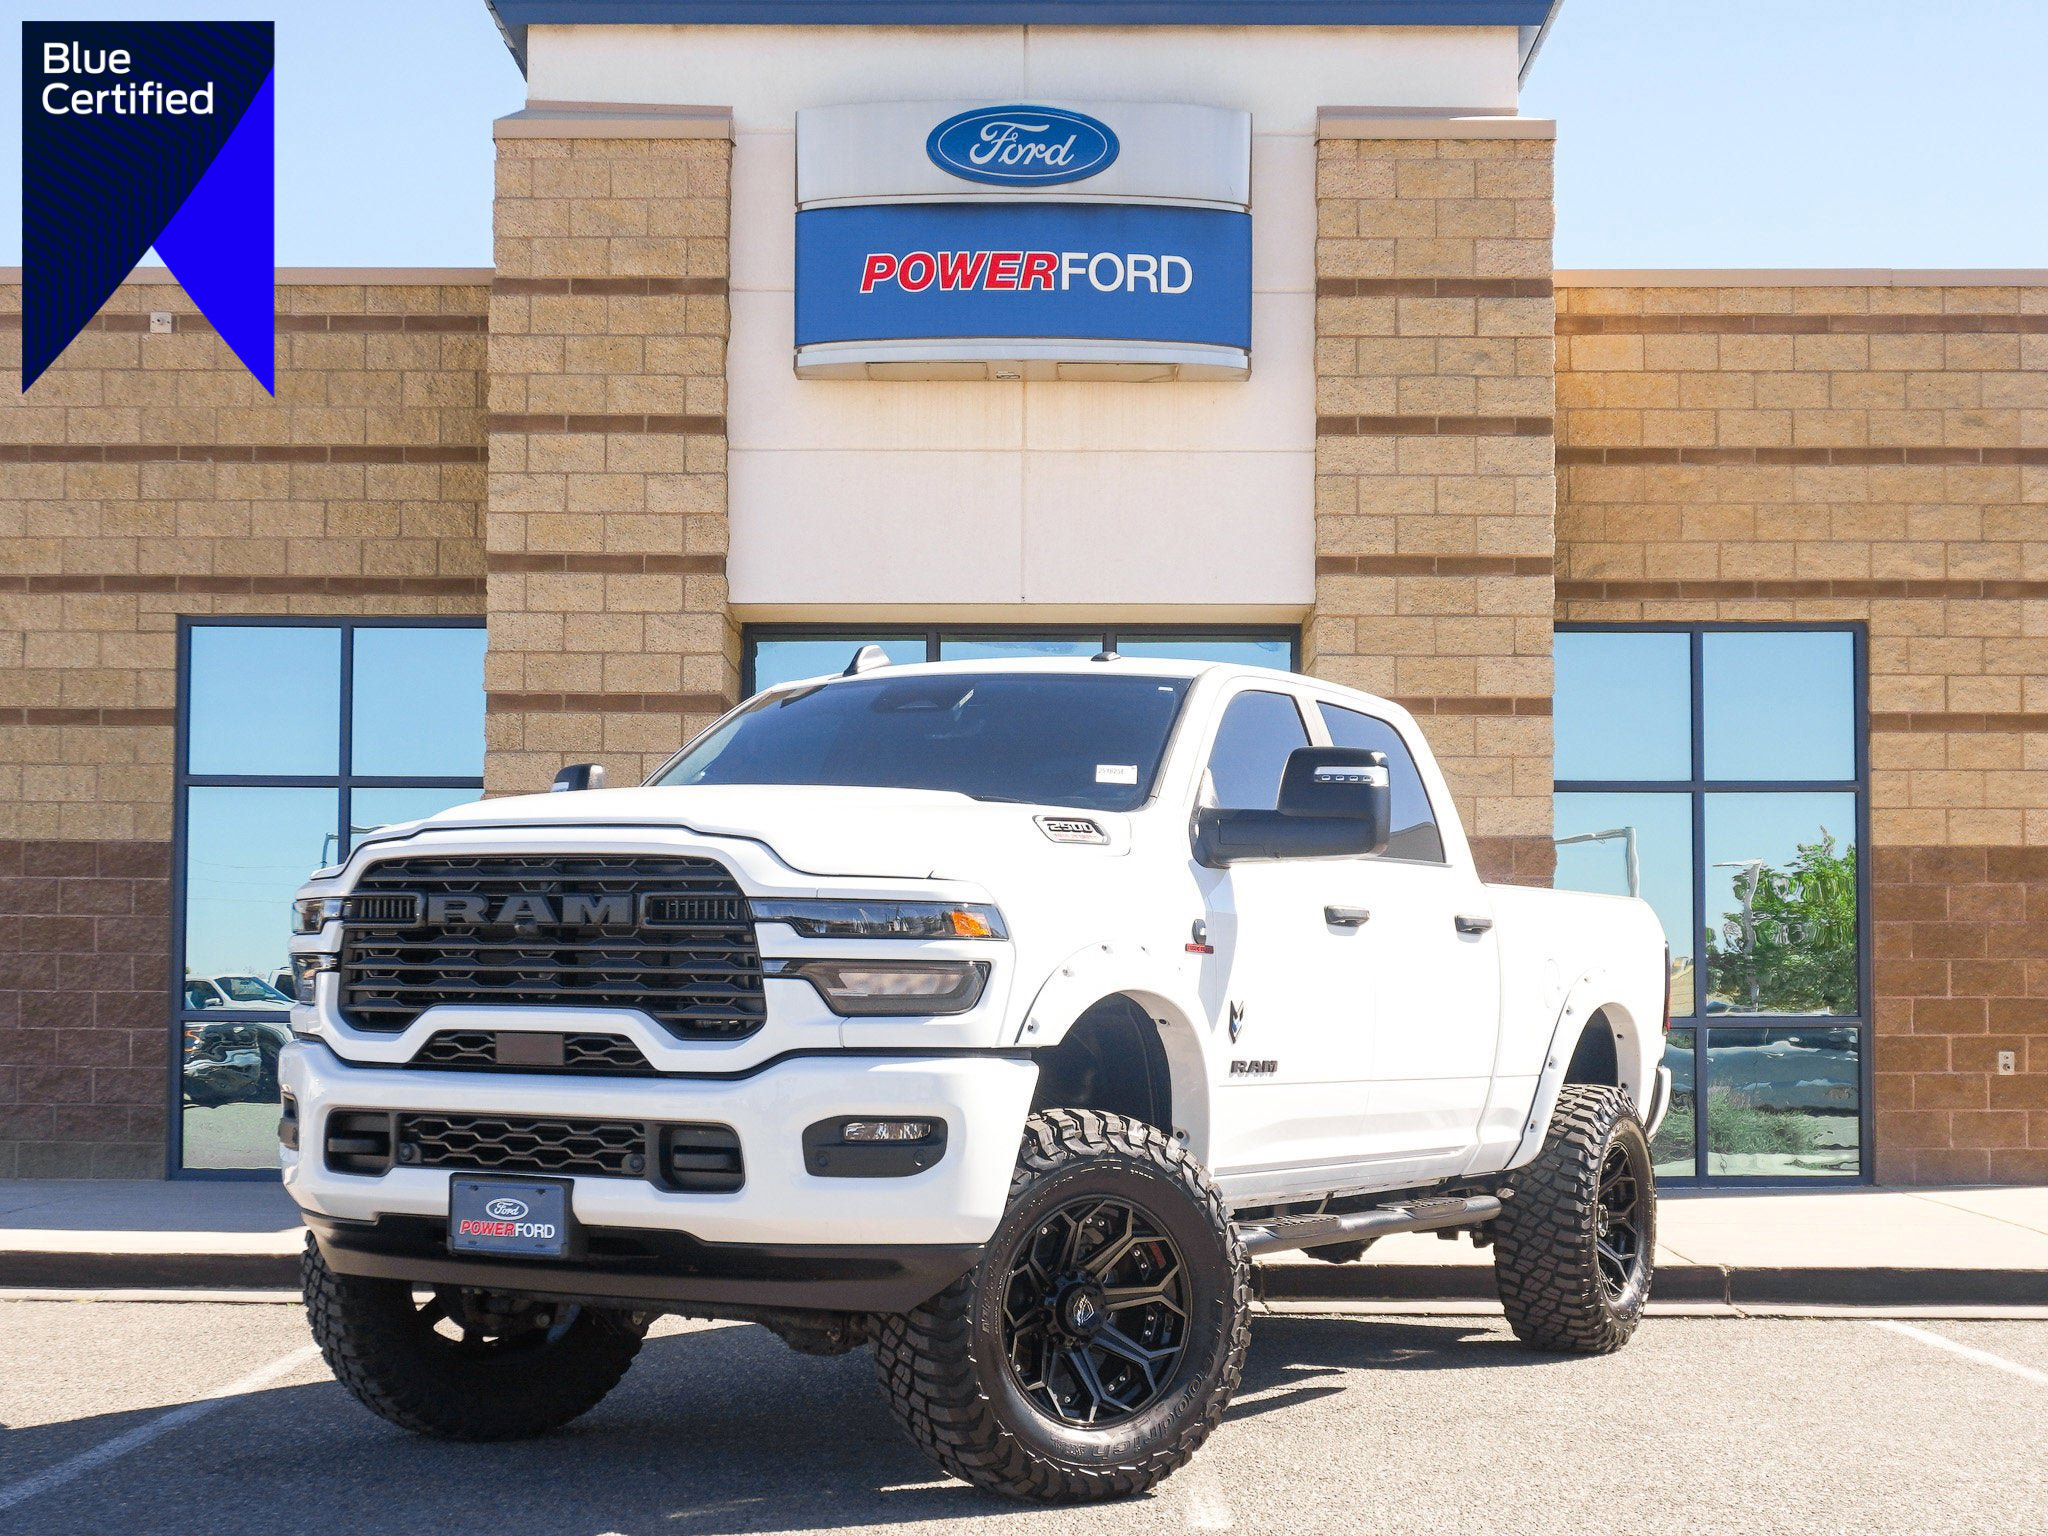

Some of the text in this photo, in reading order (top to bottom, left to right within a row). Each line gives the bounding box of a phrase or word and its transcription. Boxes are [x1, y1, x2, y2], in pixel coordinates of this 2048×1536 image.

[969, 121, 1075, 167] Ford
[860, 250, 1193, 294] POWERFORD
[1046, 822, 1093, 834] 2500
[427, 892, 633, 926] RAM
[1230, 1060, 1279, 1074] RAM
[493, 1201, 520, 1216] Ford
[459, 1219, 556, 1239] POWERFORD
